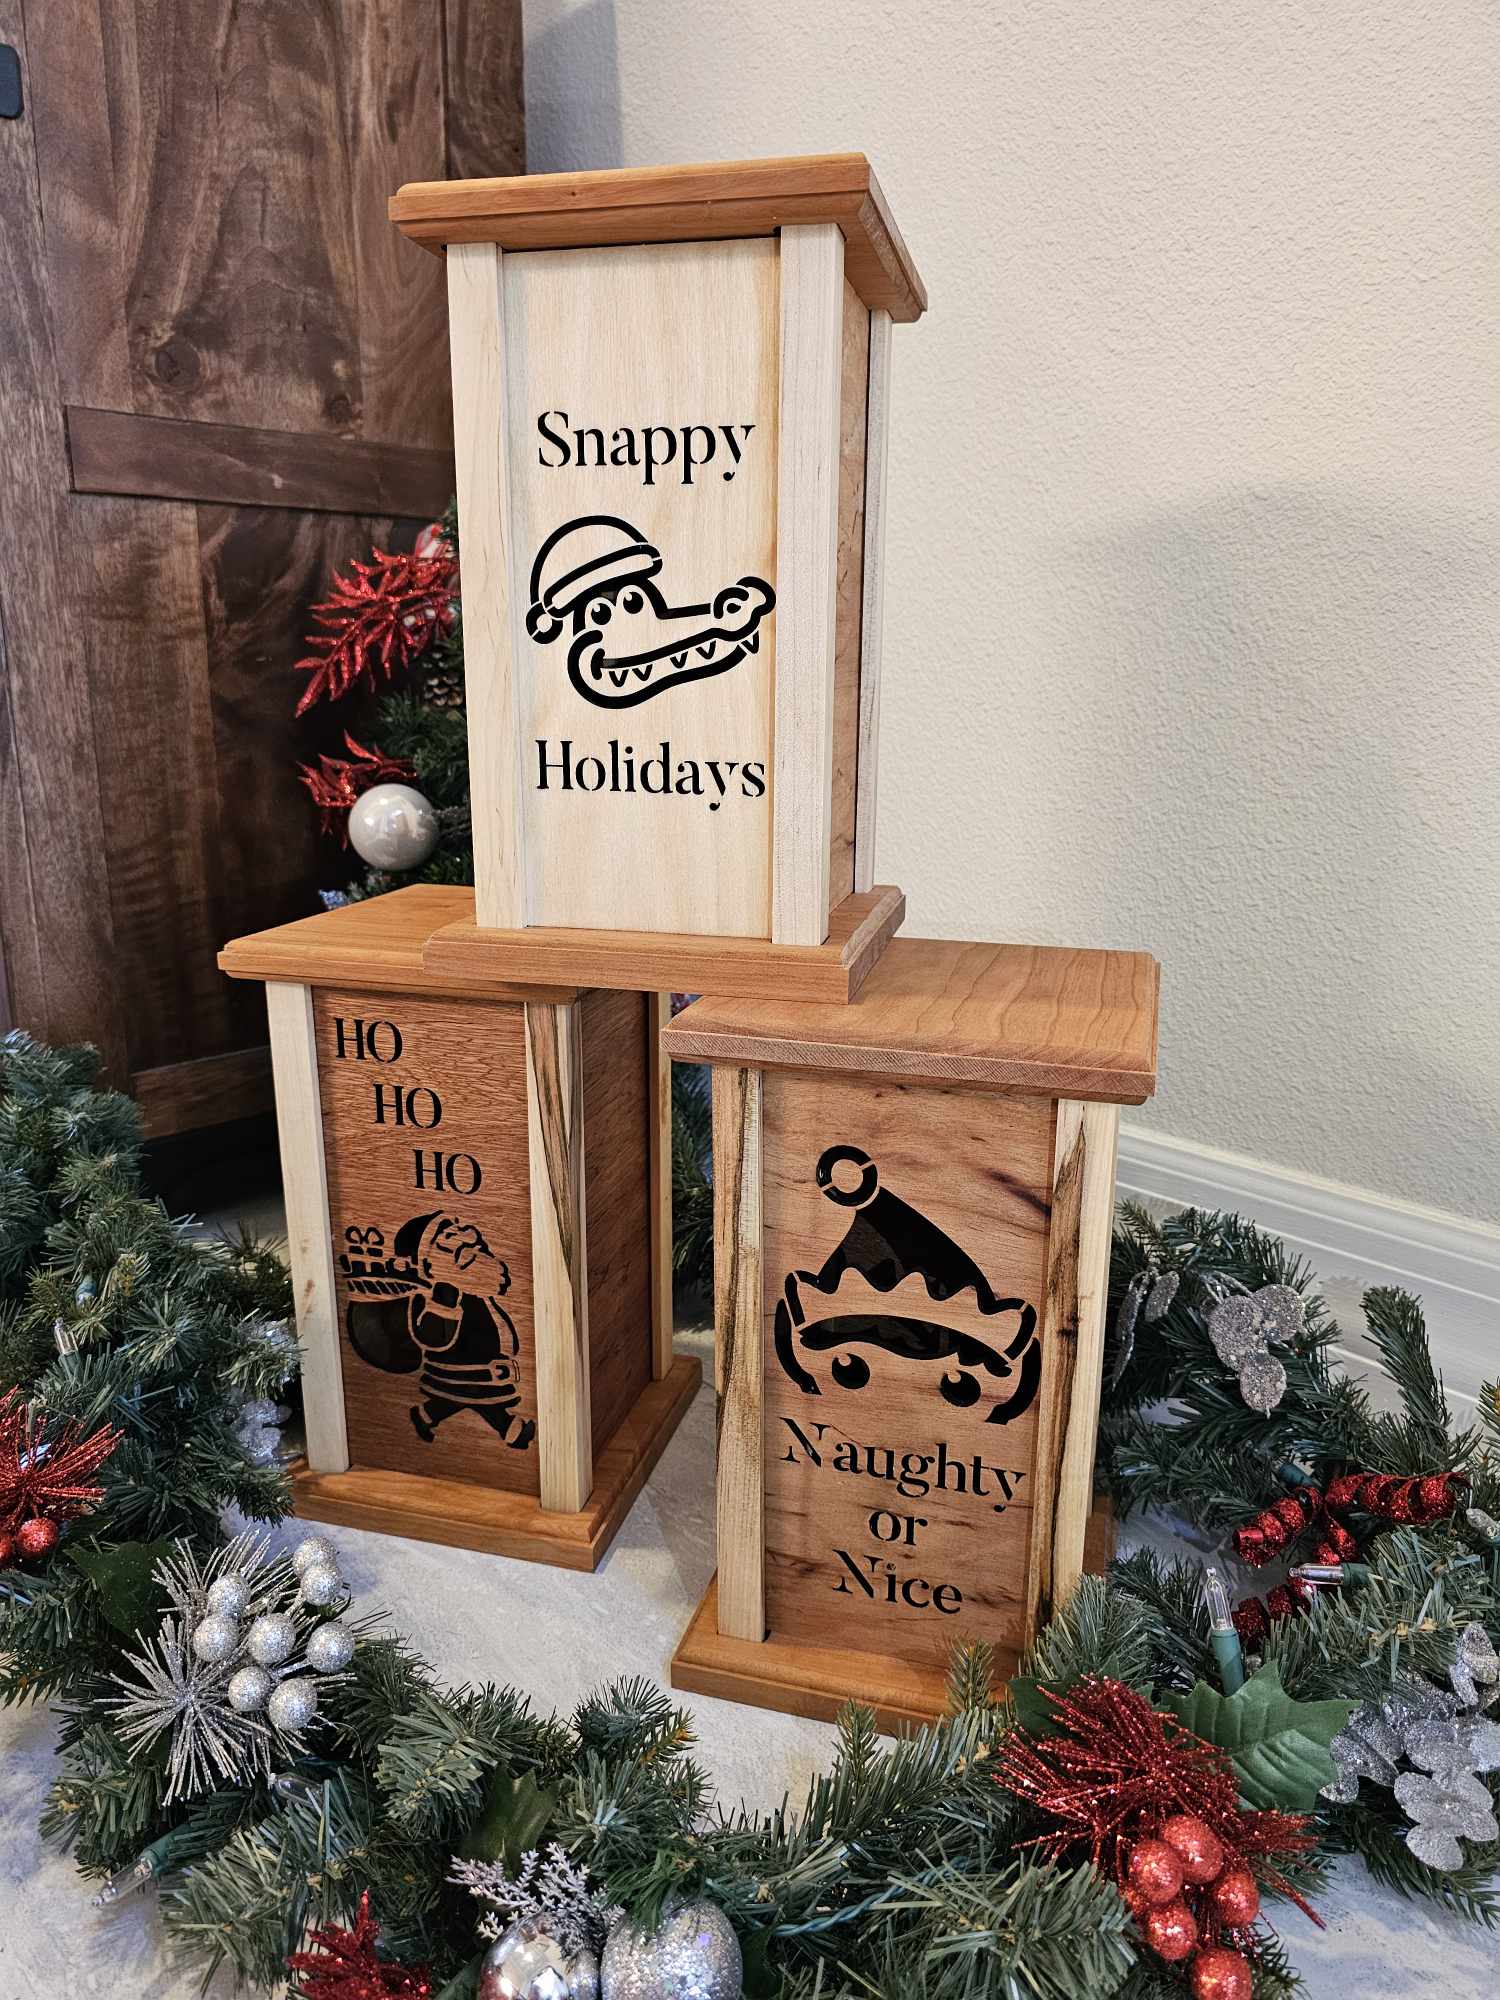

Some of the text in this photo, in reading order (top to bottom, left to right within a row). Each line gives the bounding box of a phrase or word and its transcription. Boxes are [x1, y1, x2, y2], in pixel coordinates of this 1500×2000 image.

[537, 410, 756, 485] Snappy
[534, 738, 766, 811] Holidays
[333, 1017, 403, 1064] HO
[372, 1083, 442, 1129] HO
[412, 1148, 482, 1195] HO
[779, 1416, 1027, 1513] Naughty
[868, 1511, 928, 1546] or
[832, 1549, 963, 1615] Nice
